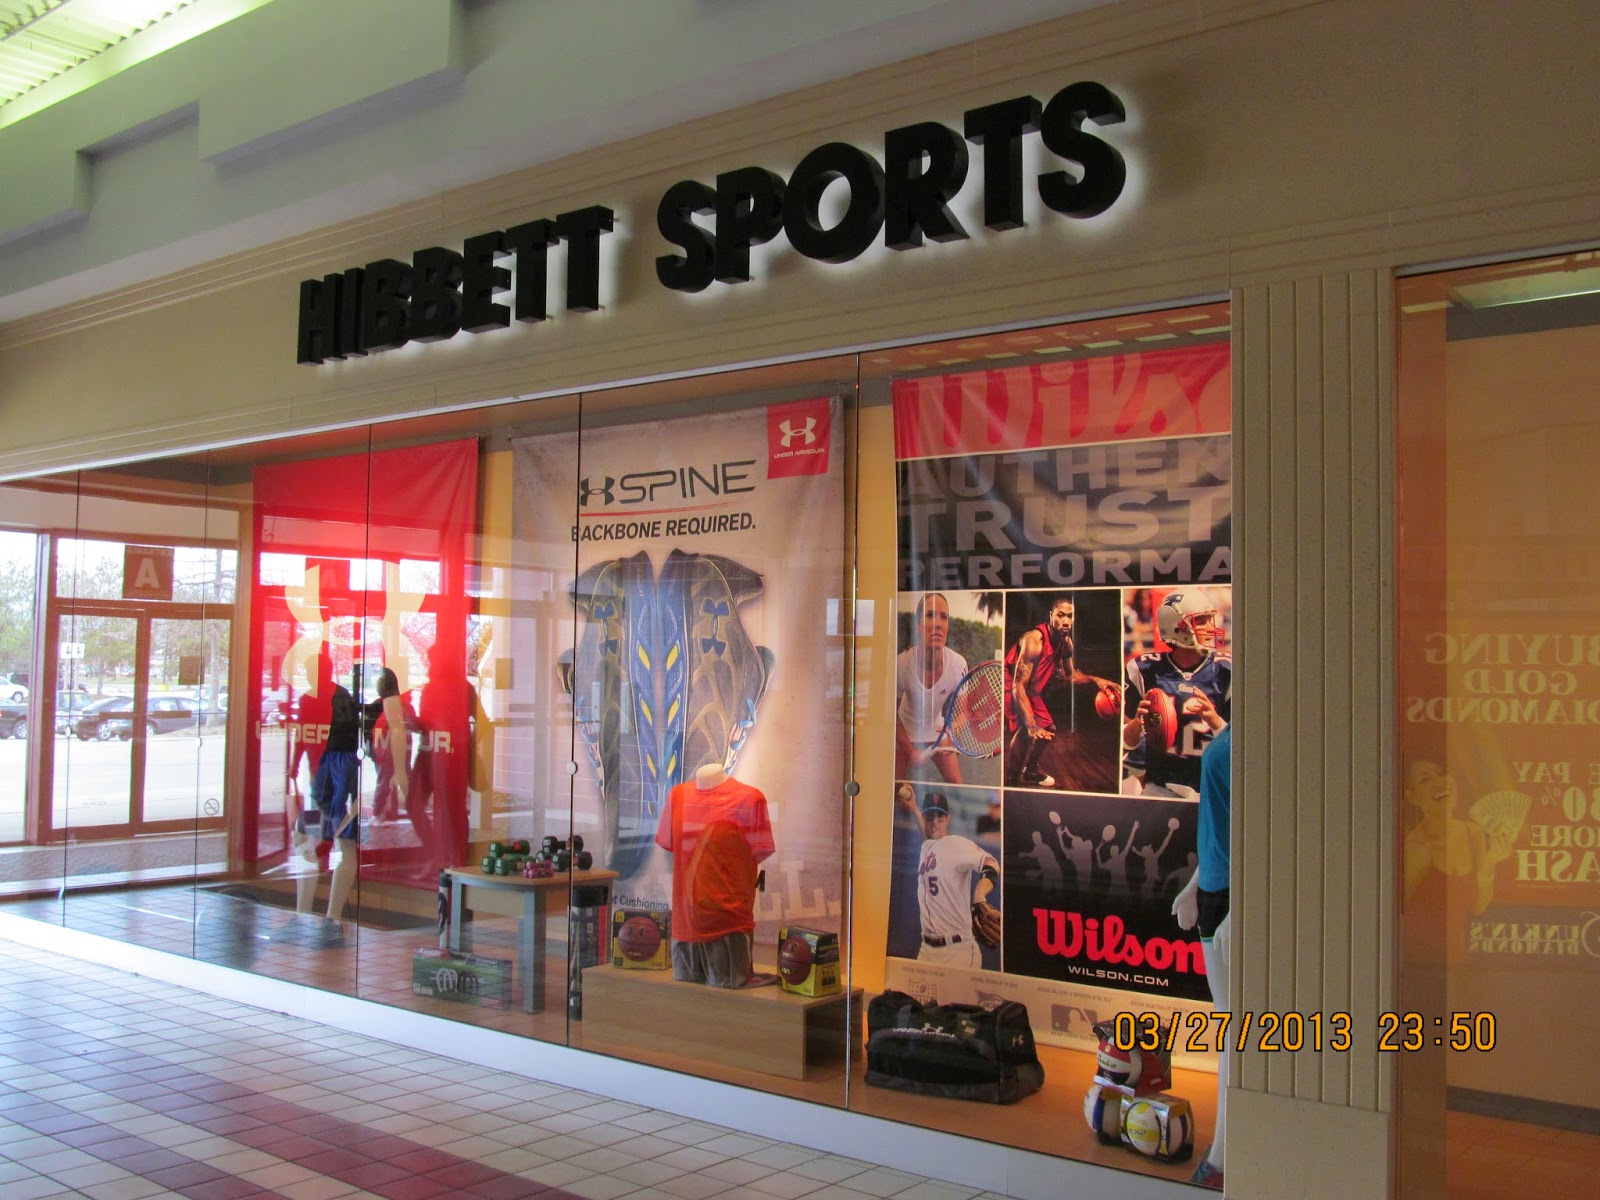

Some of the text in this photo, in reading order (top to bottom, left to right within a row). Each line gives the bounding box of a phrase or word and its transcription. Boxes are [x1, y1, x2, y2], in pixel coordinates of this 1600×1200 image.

[297, 81, 1127, 367] HIBBETT SPORTS
[773, 447, 825, 459] UNDER ARMOUR
[619, 460, 757, 504] SPINE
[571, 512, 757, 543] BACKBONE REQUIRED.
[134, 557, 160, 588] A
[902, 546, 1231, 587] PERFORMA
[928, 875, 939, 897] 5
[619, 895, 670, 912] Cushioning
[1033, 907, 1207, 975] Wilson
[1068, 965, 1169, 987] WILSON.COM
